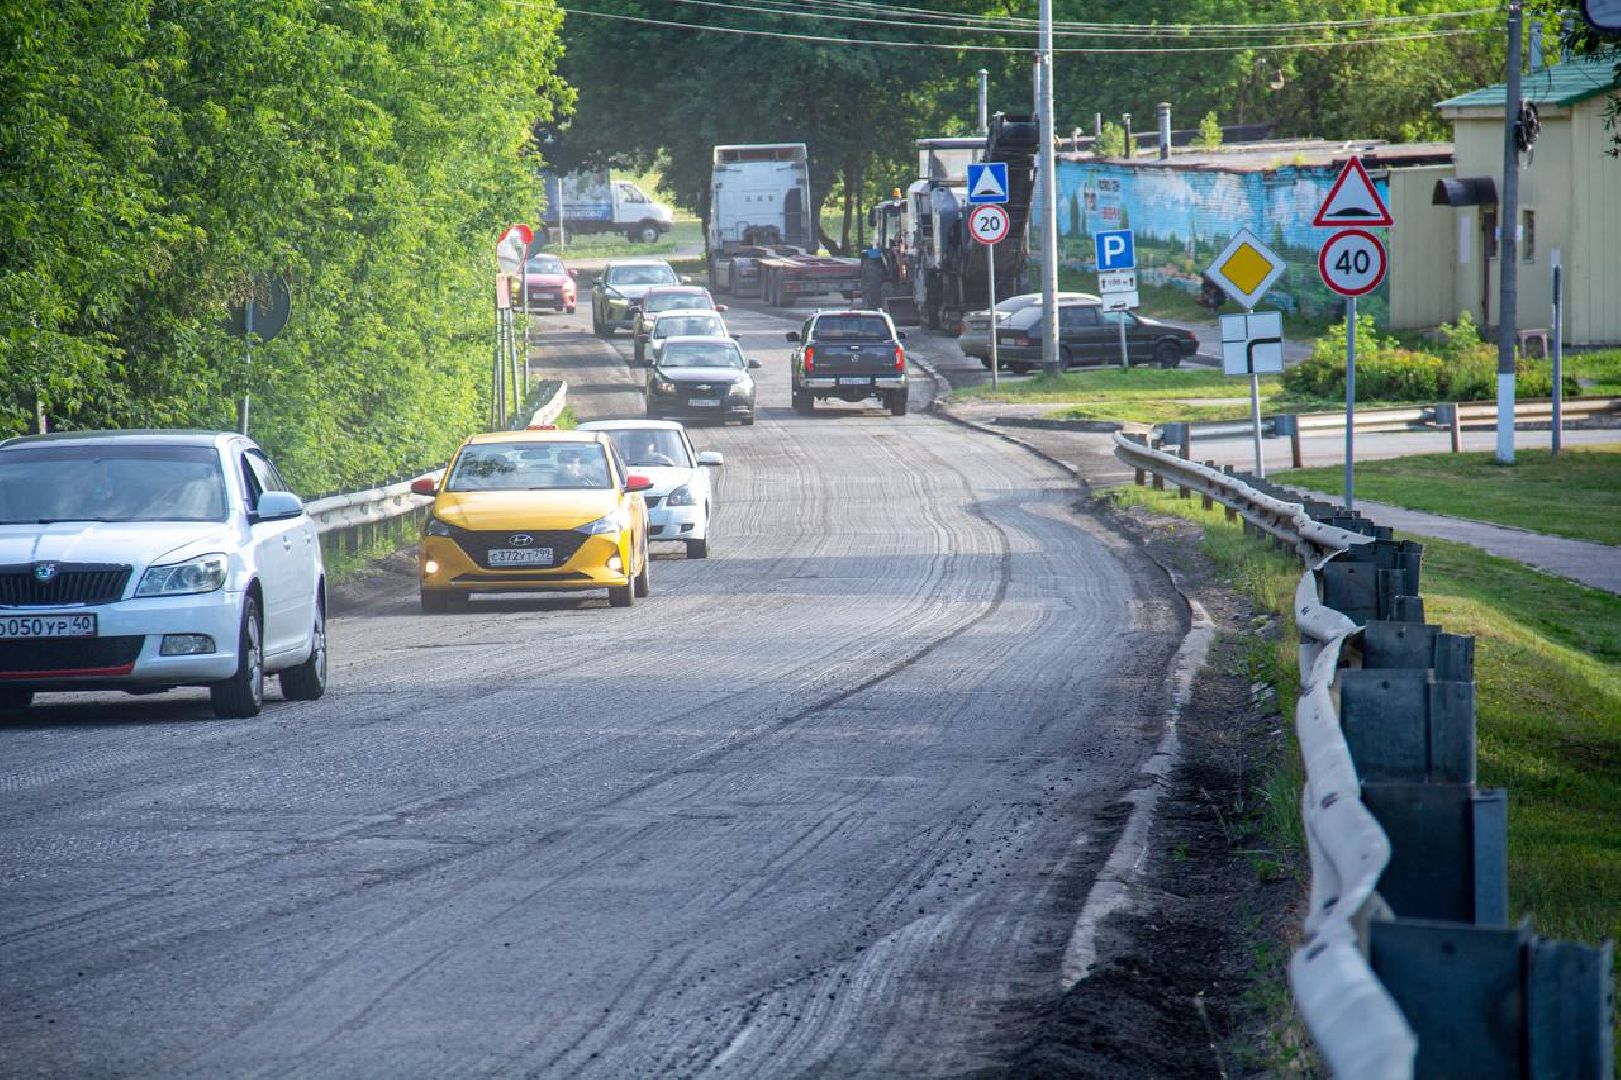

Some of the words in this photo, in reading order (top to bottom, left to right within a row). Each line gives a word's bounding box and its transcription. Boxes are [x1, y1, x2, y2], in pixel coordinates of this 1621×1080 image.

[980, 216, 1000, 231] 20
[1104, 235, 1125, 266] P
[1335, 249, 1371, 274] 40
